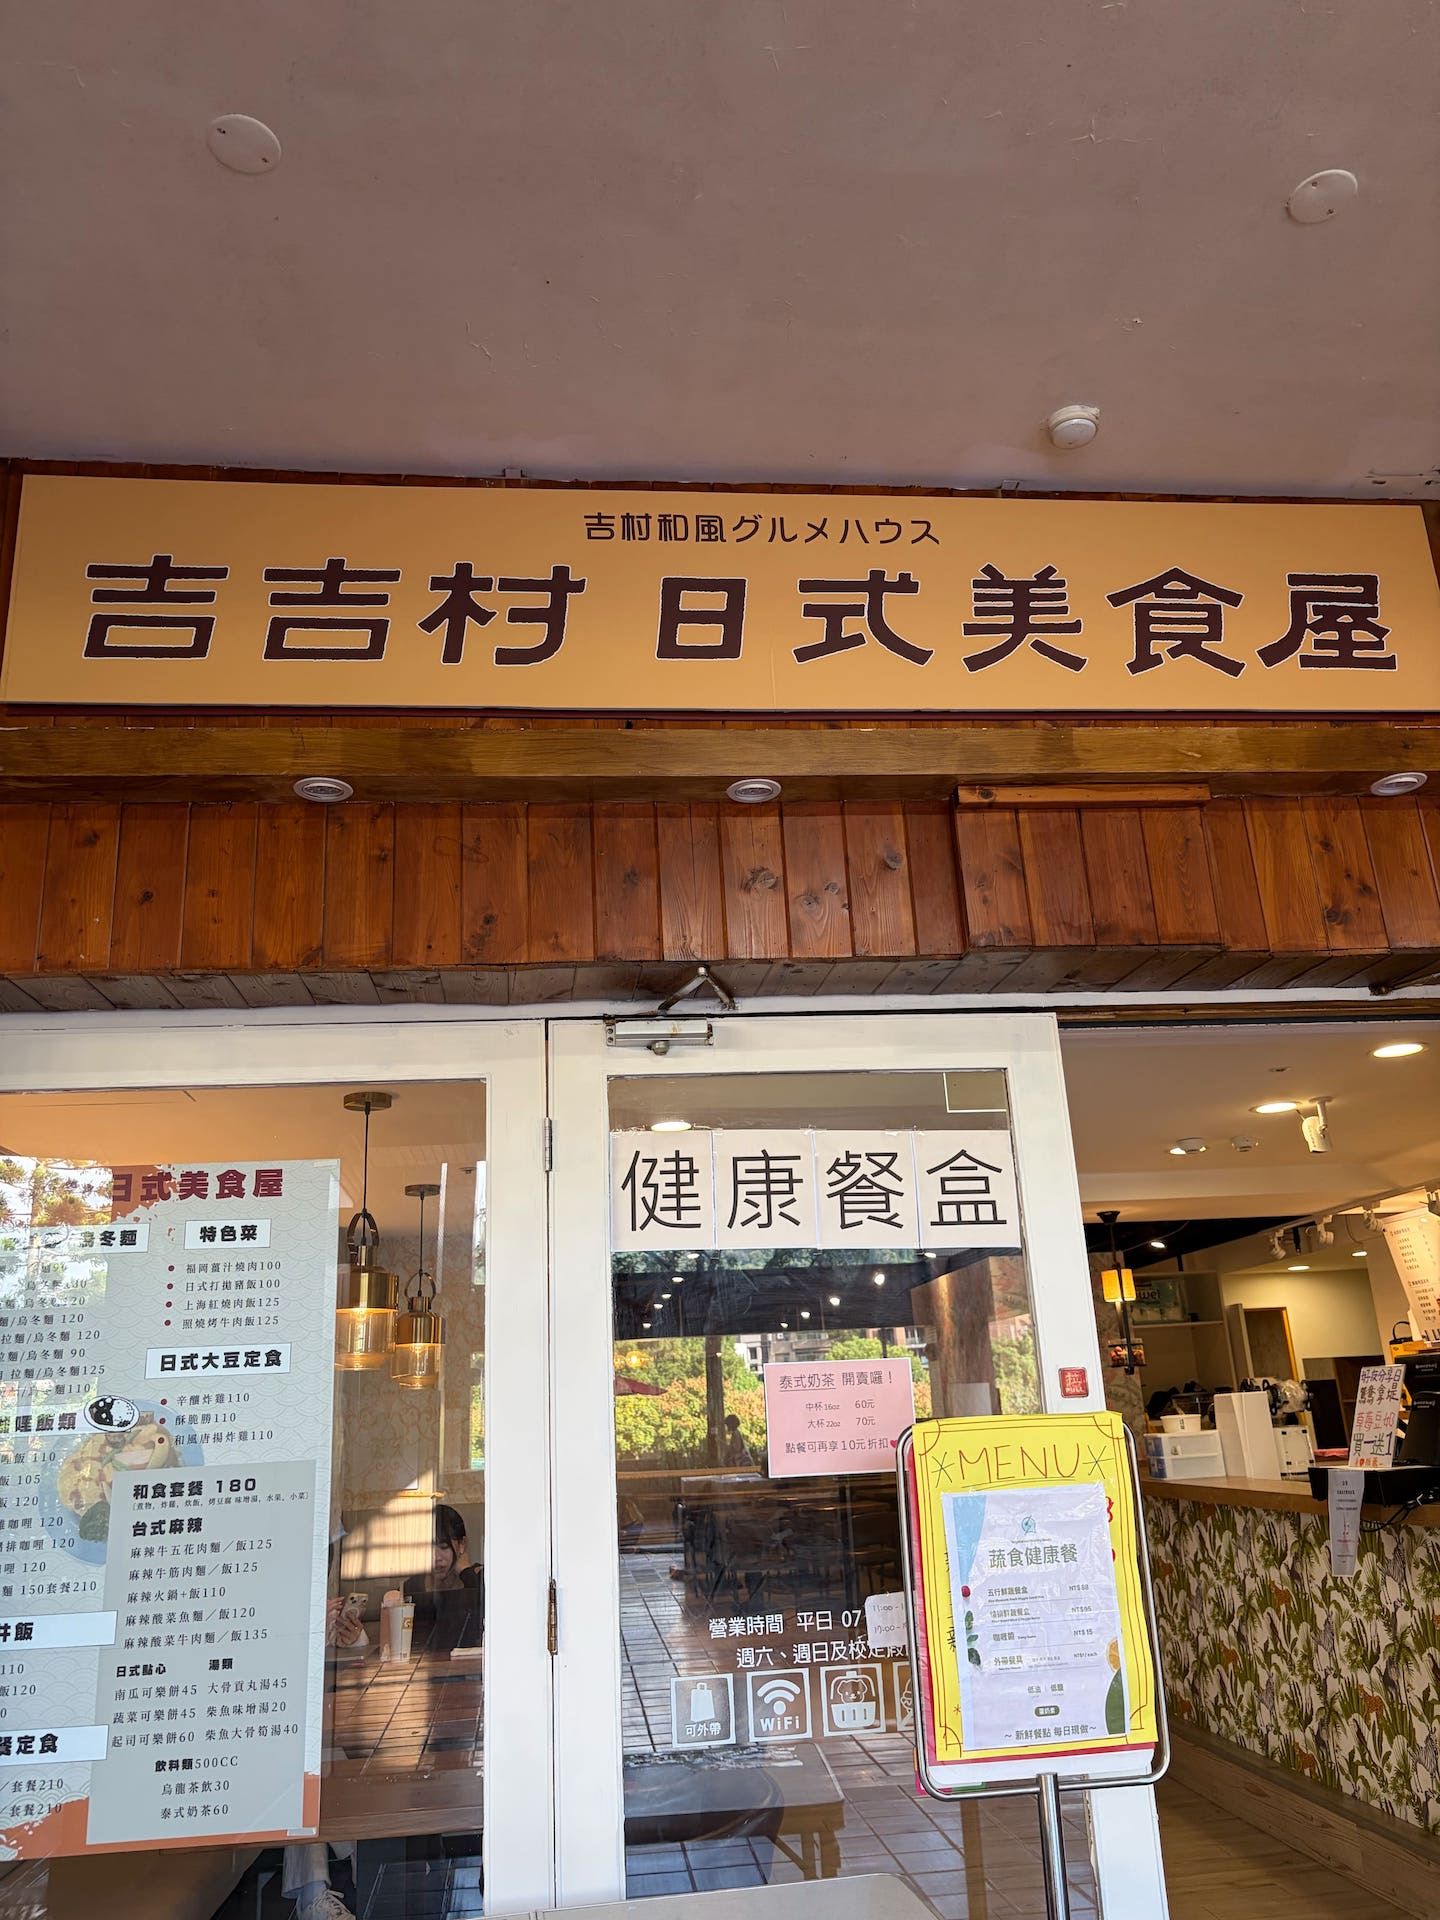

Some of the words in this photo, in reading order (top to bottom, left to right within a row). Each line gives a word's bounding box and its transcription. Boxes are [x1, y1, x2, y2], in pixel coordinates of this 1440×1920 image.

[584, 512, 939, 546] 吉村和風グルメハウス
[82, 553, 587, 667] 吉吉村
[656, 562, 1397, 677] 日式美食屋
[621, 1149, 1008, 1232] 健康餐盒
[200, 1224, 258, 1243] 特色菜
[184, 1297, 280, 1311] 上海紅燒肉飯125
[61, 1313, 84, 1324] 120
[182, 1315, 279, 1330] 照燒烤牛肉飯125
[78, 1330, 100, 1340] 120
[70, 1348, 86, 1358] 90
[160, 1349, 282, 1372] 日式大豆定食
[779, 1373, 835, 1389] 泰式奶茶
[854, 1398, 876, 1409] 60元
[855, 1416, 876, 1427] 70元
[174, 1430, 273, 1446] 和風唐揚炸雞110
[32, 1451, 56, 1462] 110
[958, 1443, 1080, 1483] MENU
[17, 1474, 41, 1485] 105
[132, 1480, 203, 1500] 和食套餐
[216, 1477, 257, 1493] 180
[15, 1495, 39, 1507] 120
[40, 1516, 63, 1527] 120
[132, 1517, 203, 1537] 台式麻辣
[51, 1537, 75, 1548] 120
[988, 1543, 1078, 1569] 蔬食健康餐
[22, 1560, 46, 1572] 120
[708, 1614, 784, 1639] 營業時間
[797, 1611, 833, 1632] 平日
[116, 1663, 167, 1678] 日式點心
[208, 1657, 234, 1671] 湯類
[114, 1684, 198, 1701] 南瓜可樂餅45
[207, 1678, 288, 1695] 大骨貢丸湯45
[113, 1708, 196, 1724] 蔬菜可樂餅45
[206, 1701, 287, 1718] 柴魚味增湯20
[685, 1722, 722, 1736] 可外帶
[760, 1715, 800, 1732] WiFi
[111, 1731, 195, 1748] 起司可樂餅60
[205, 1723, 299, 1741] 柴魚大骨筍湯40
[161, 1780, 230, 1796] 烏龍茶飲30
[160, 1804, 229, 1820] 泰式奶茶60
